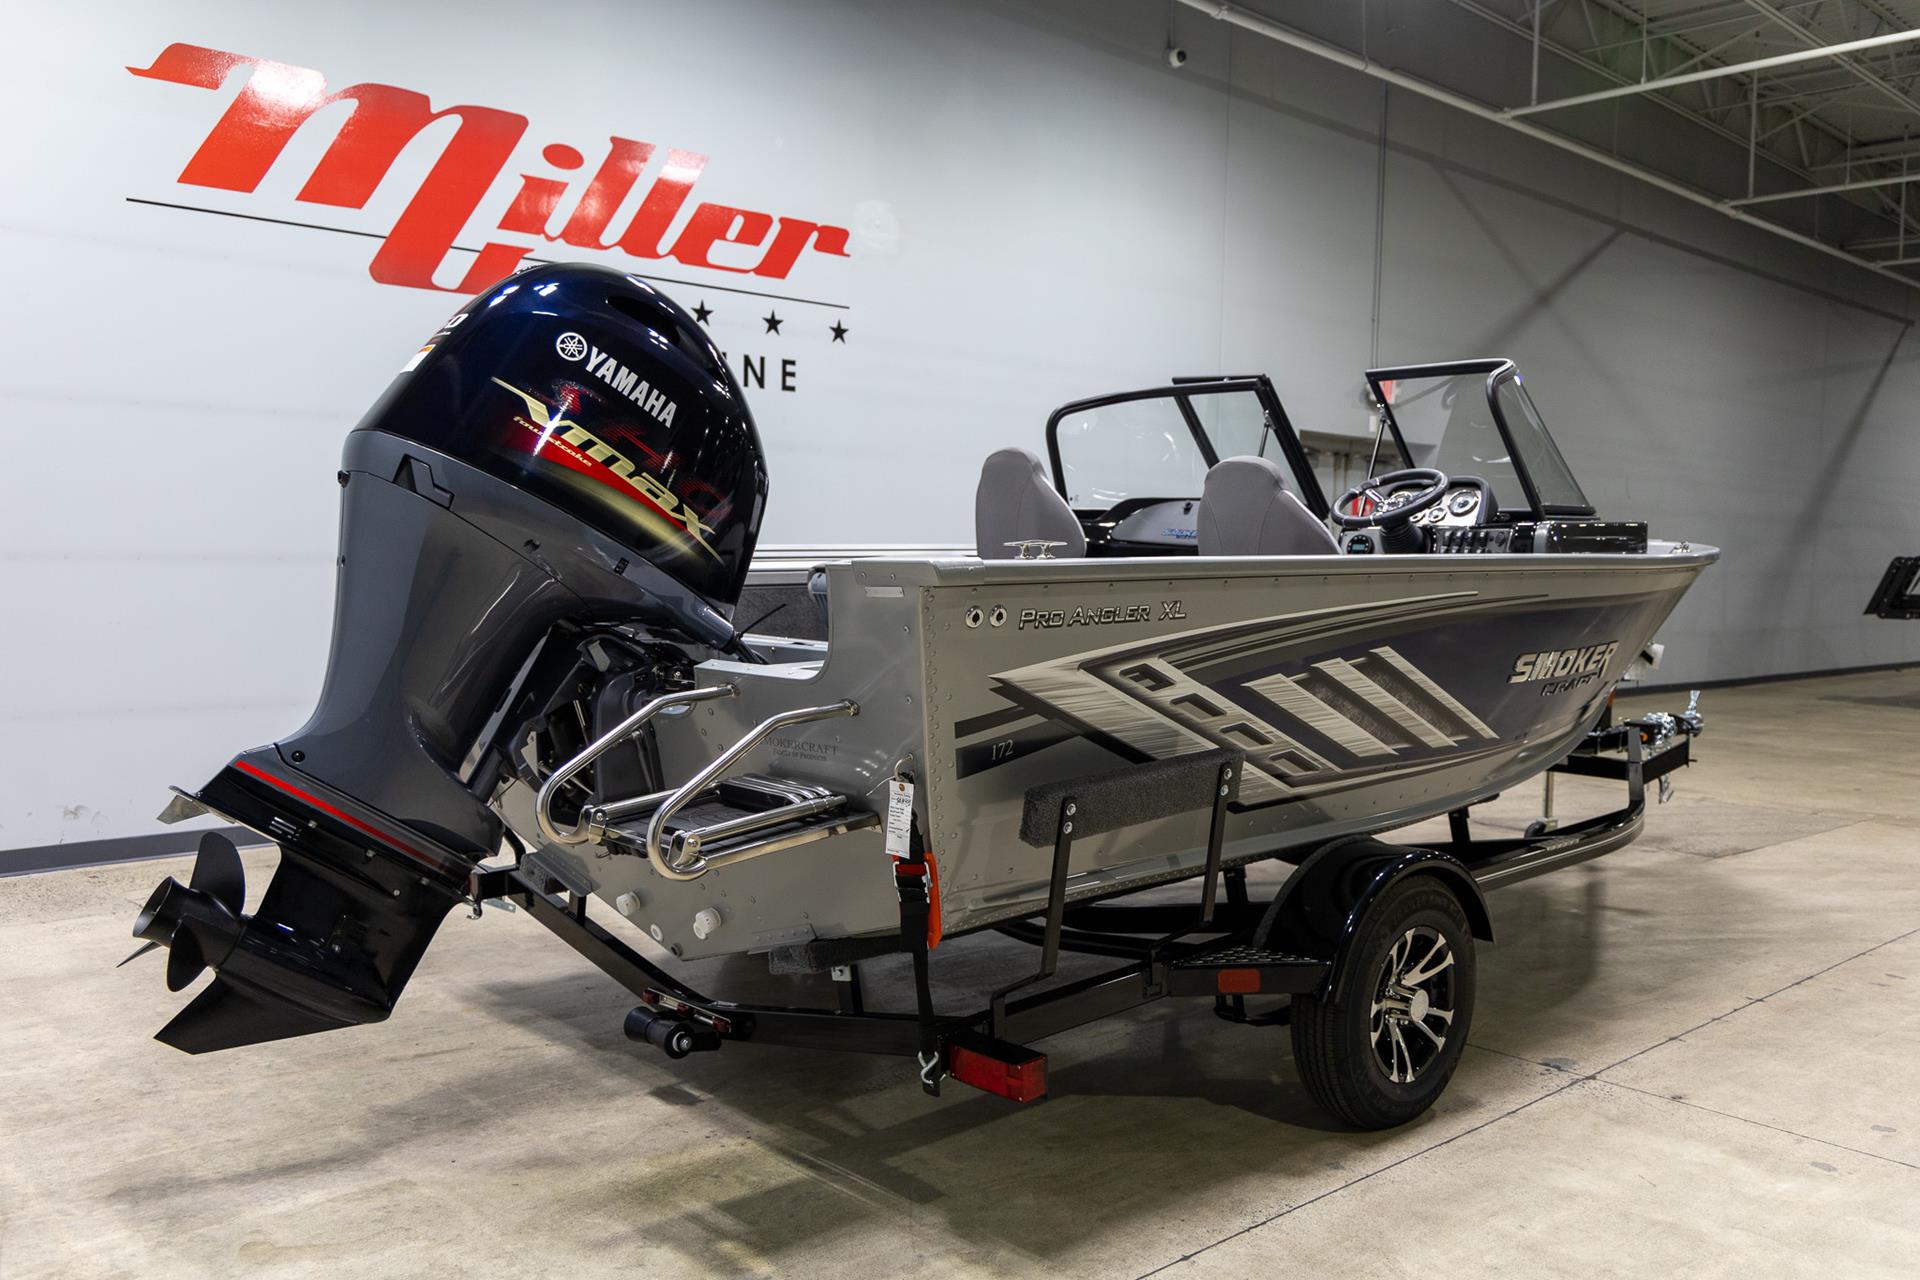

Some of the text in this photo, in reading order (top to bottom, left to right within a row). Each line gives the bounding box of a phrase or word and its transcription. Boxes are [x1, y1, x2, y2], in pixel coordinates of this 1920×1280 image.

[583, 345, 678, 429] YAMAHA
[1067, 604, 1151, 628] ANGLER
[1158, 599, 1187, 621] XL
[1506, 639, 1620, 685] SMOKER
[1540, 671, 1598, 697] CRAFT
[761, 735, 839, 755] MOKERCRAFT
[991, 738, 1015, 761] 172
